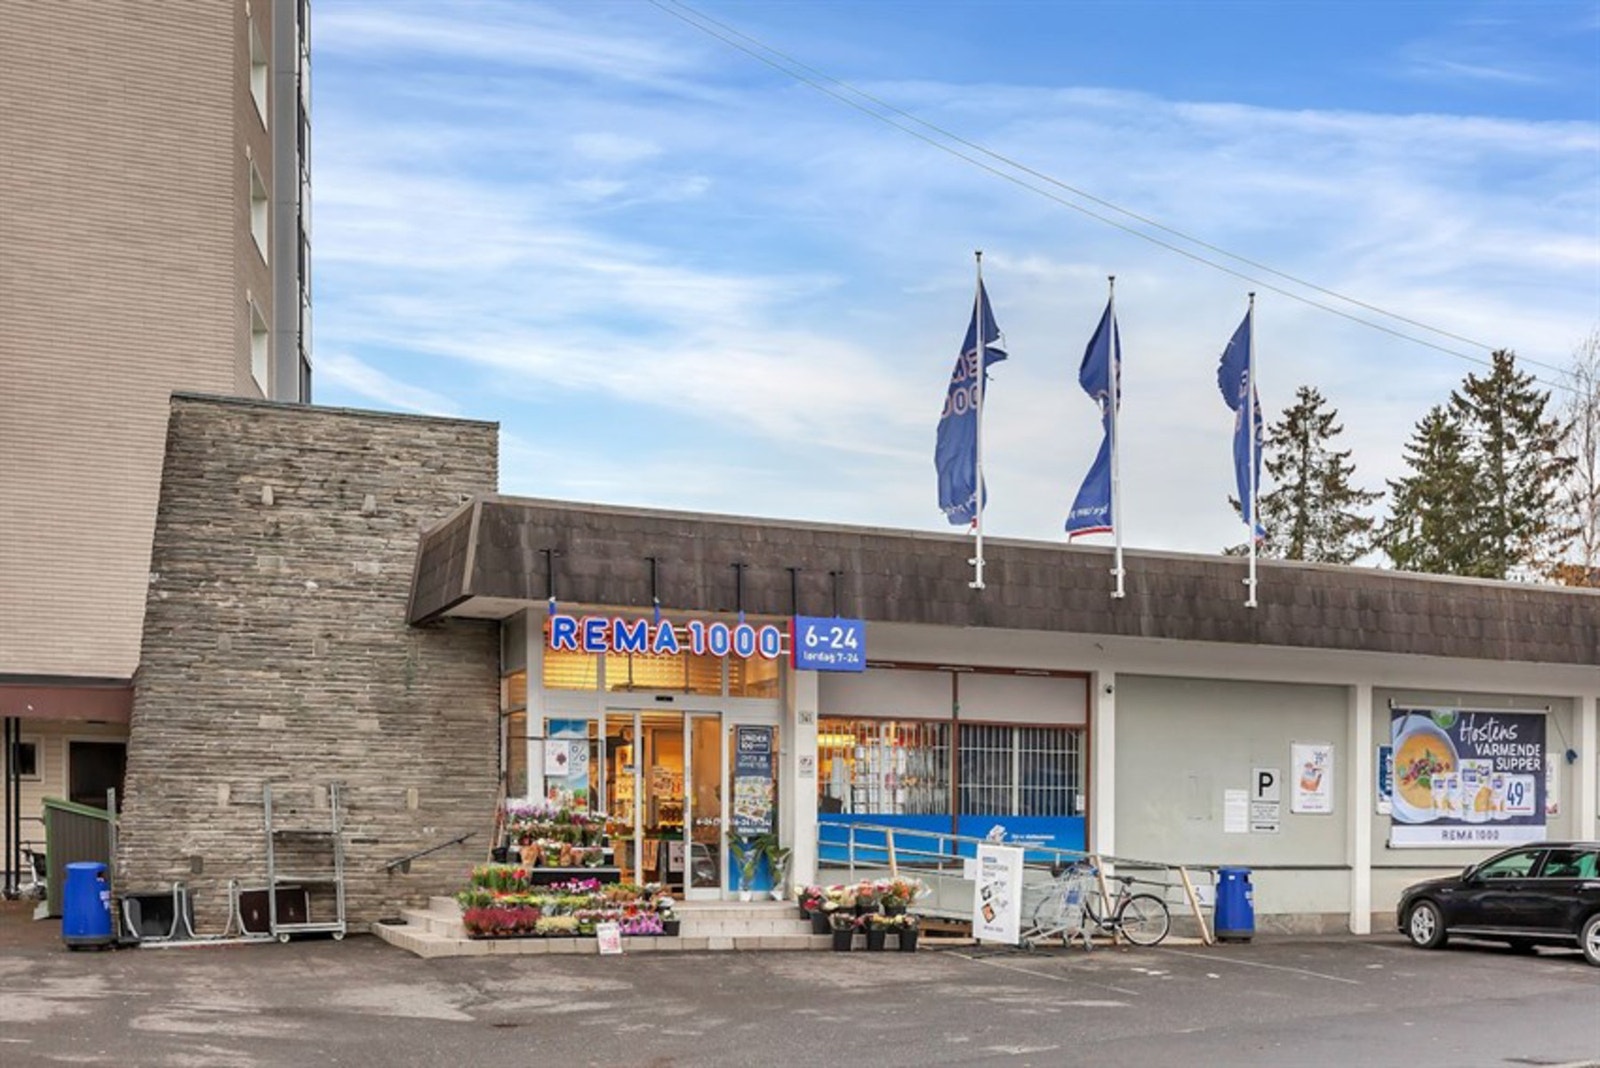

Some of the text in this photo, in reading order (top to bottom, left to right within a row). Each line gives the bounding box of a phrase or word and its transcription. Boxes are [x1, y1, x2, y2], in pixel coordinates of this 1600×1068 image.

[551, 615, 781, 659] REMA 1000
[805, 625, 858, 649] 6-24
[1474, 742, 1541, 757] VARMENDE
[1495, 757, 1541, 771] SUPPER
[1259, 771, 1274, 797] P
[1507, 781, 1525, 806] 49
[1441, 829, 1500, 841] REMA 1000
